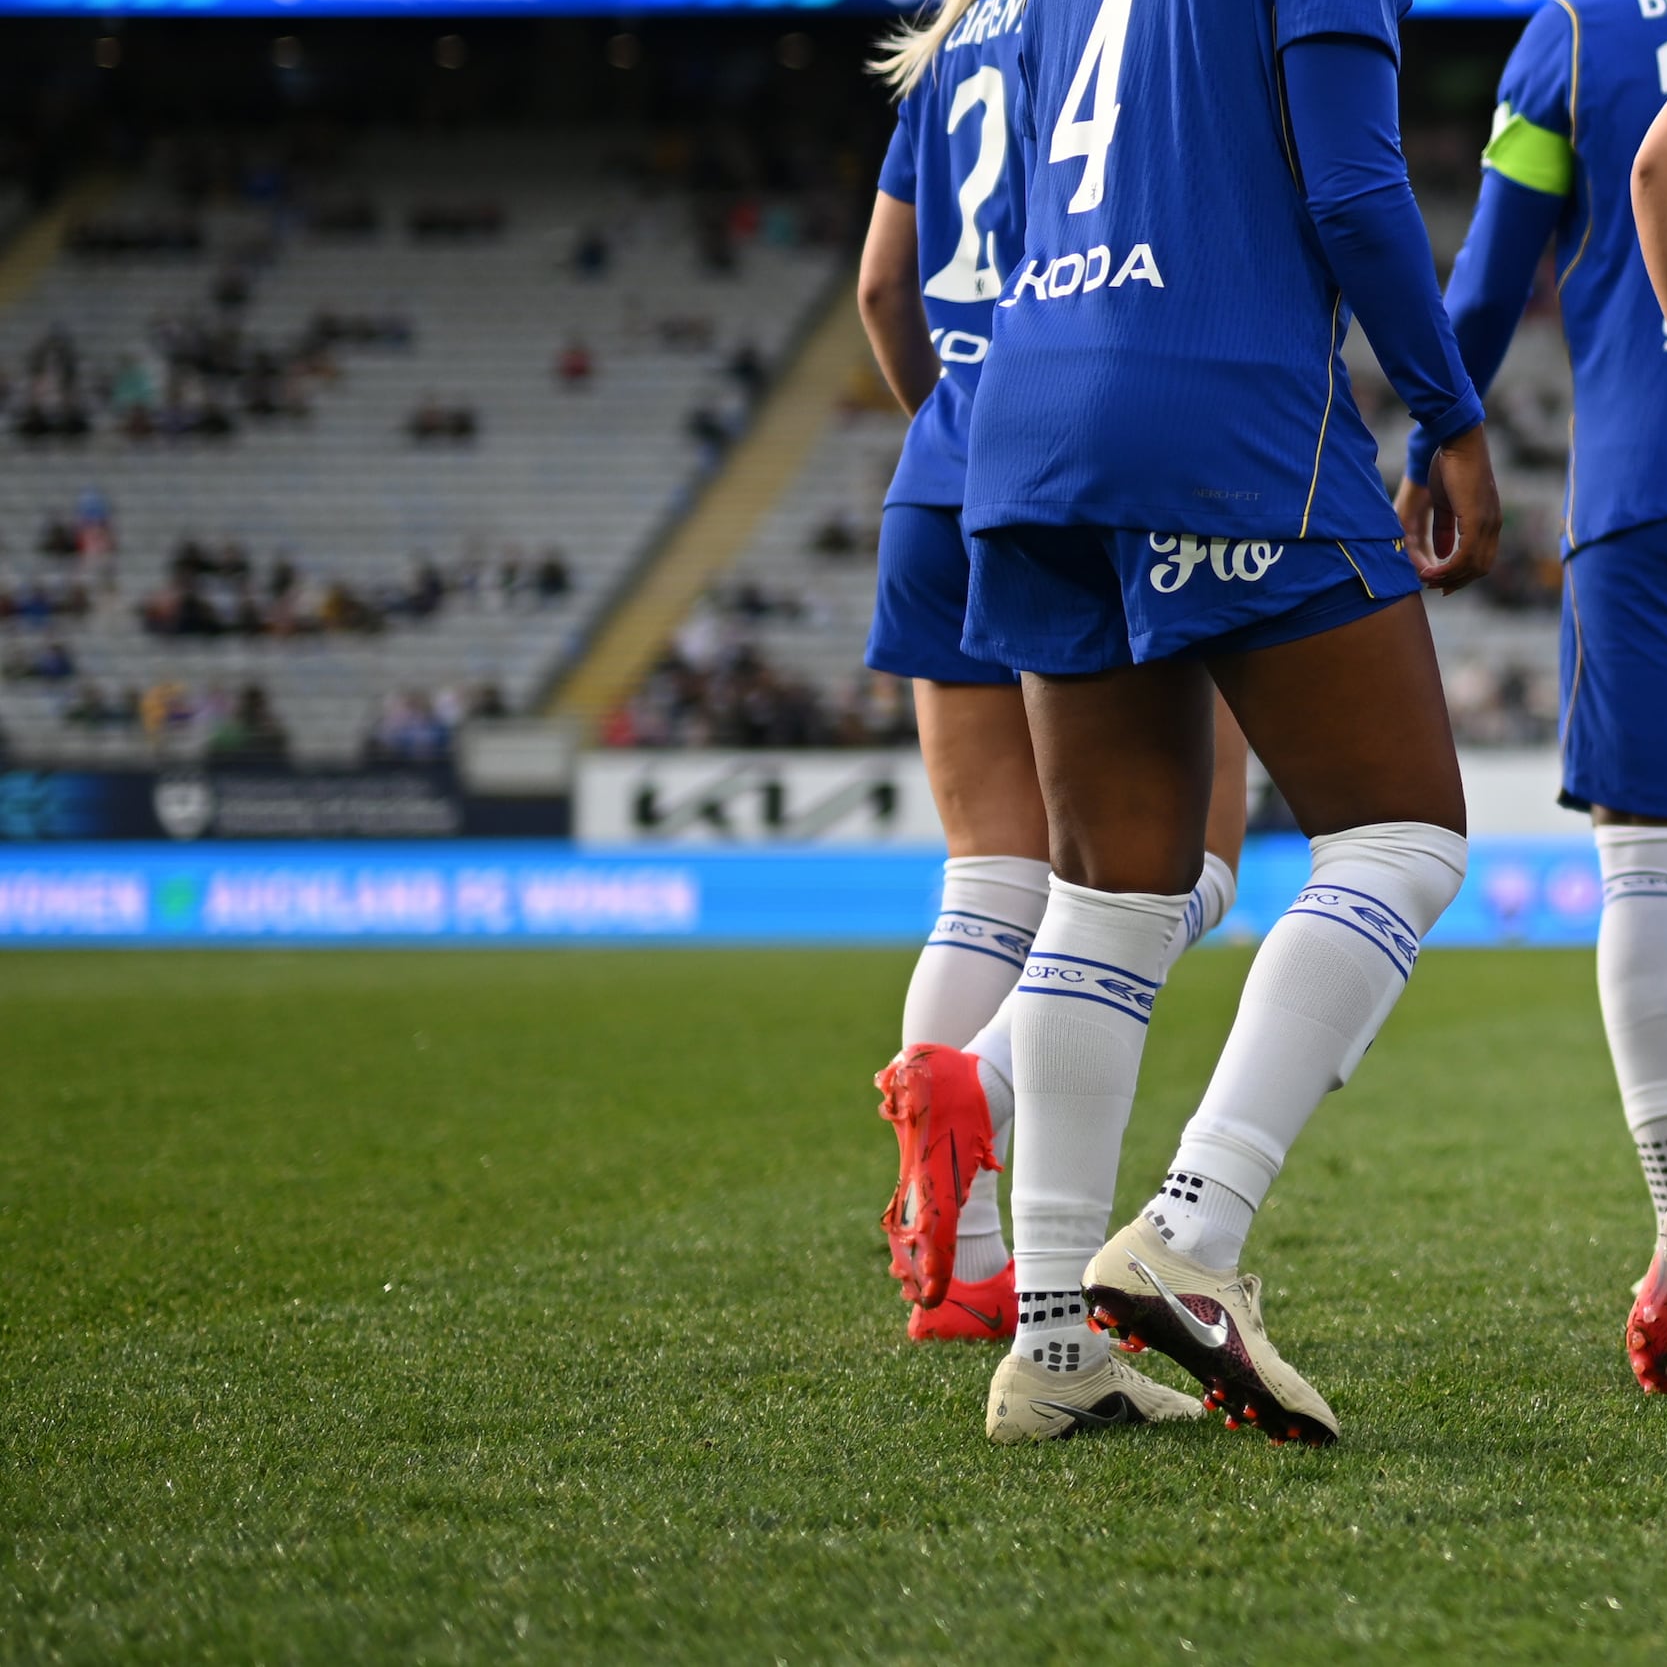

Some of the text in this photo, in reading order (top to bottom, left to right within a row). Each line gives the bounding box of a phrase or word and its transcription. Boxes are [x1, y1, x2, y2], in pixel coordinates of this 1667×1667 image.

[924, 66, 1004, 303] 2
[998, 243, 1165, 308] KODA
[1296, 893, 1340, 906] FC
[1026, 965, 1085, 983] CFC
